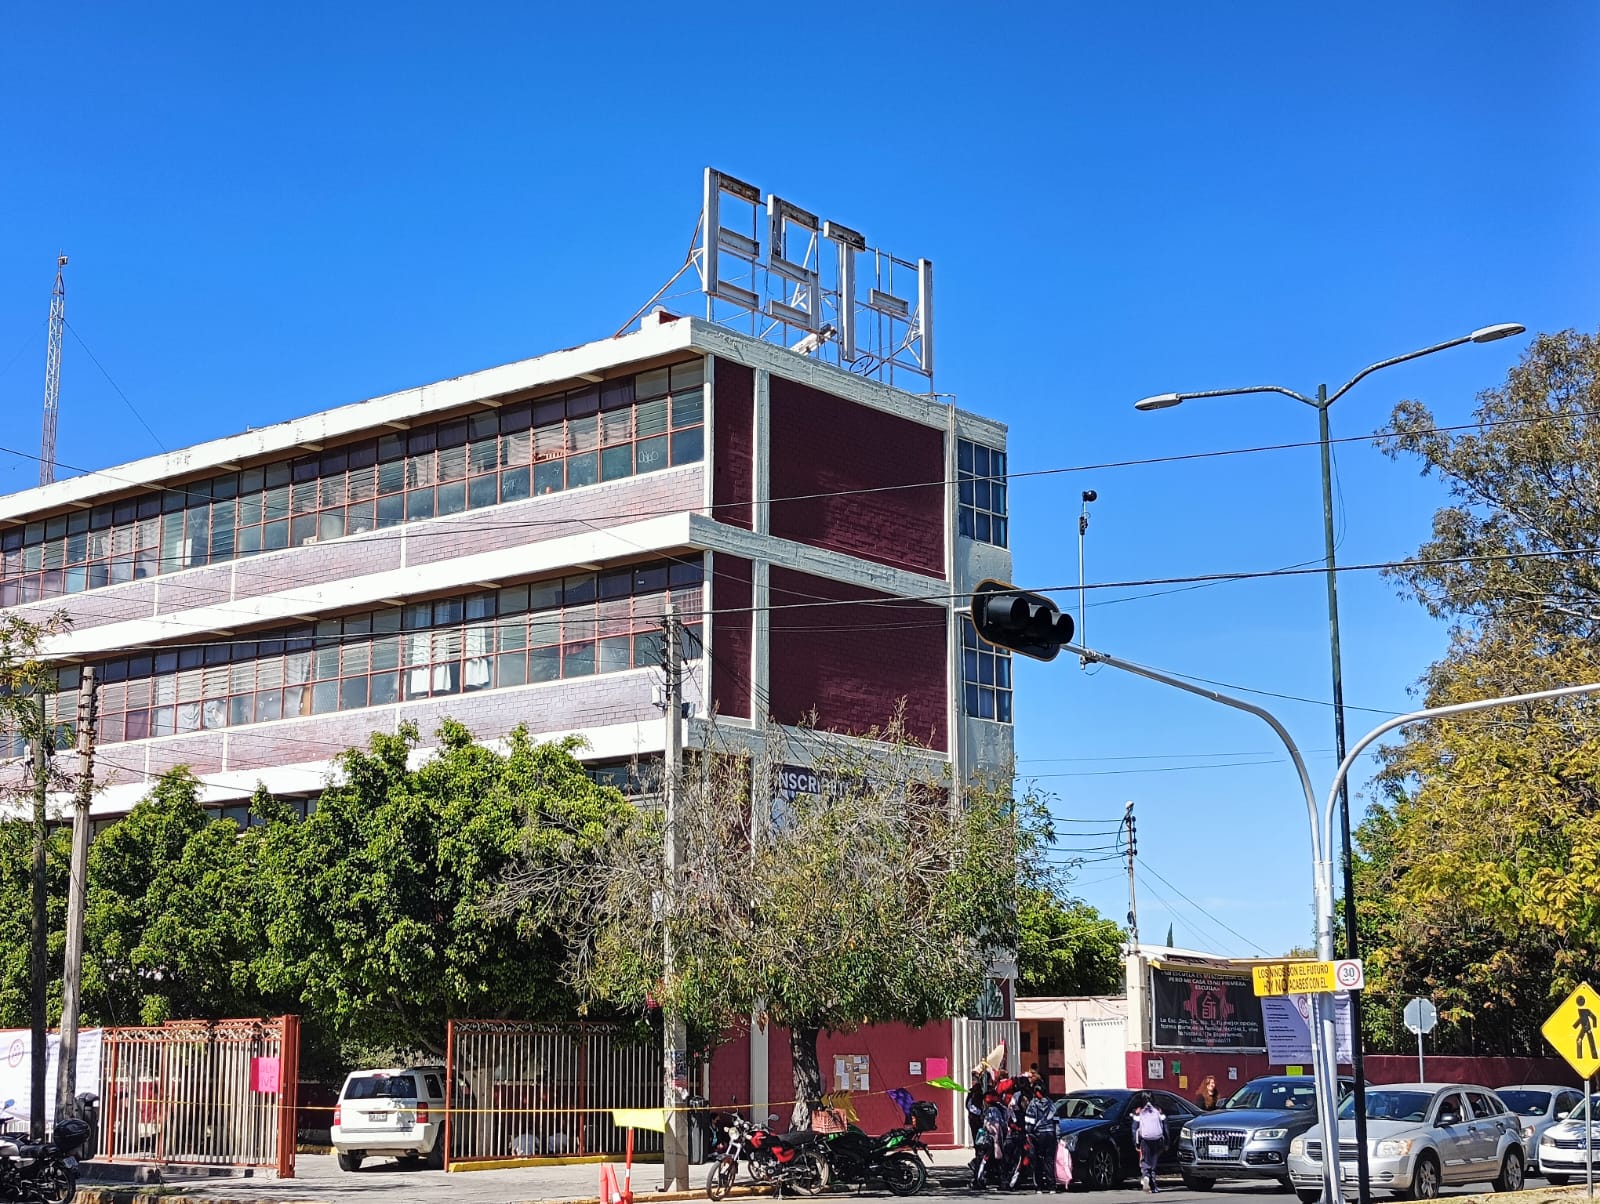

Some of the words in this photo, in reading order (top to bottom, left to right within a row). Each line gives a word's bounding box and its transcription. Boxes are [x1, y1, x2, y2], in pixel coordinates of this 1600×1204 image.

[1299, 966, 1306, 975] EL
[1306, 964, 1329, 975] FUTURO
[1343, 967, 1355, 978] 30
[1275, 977, 1288, 992] NO
